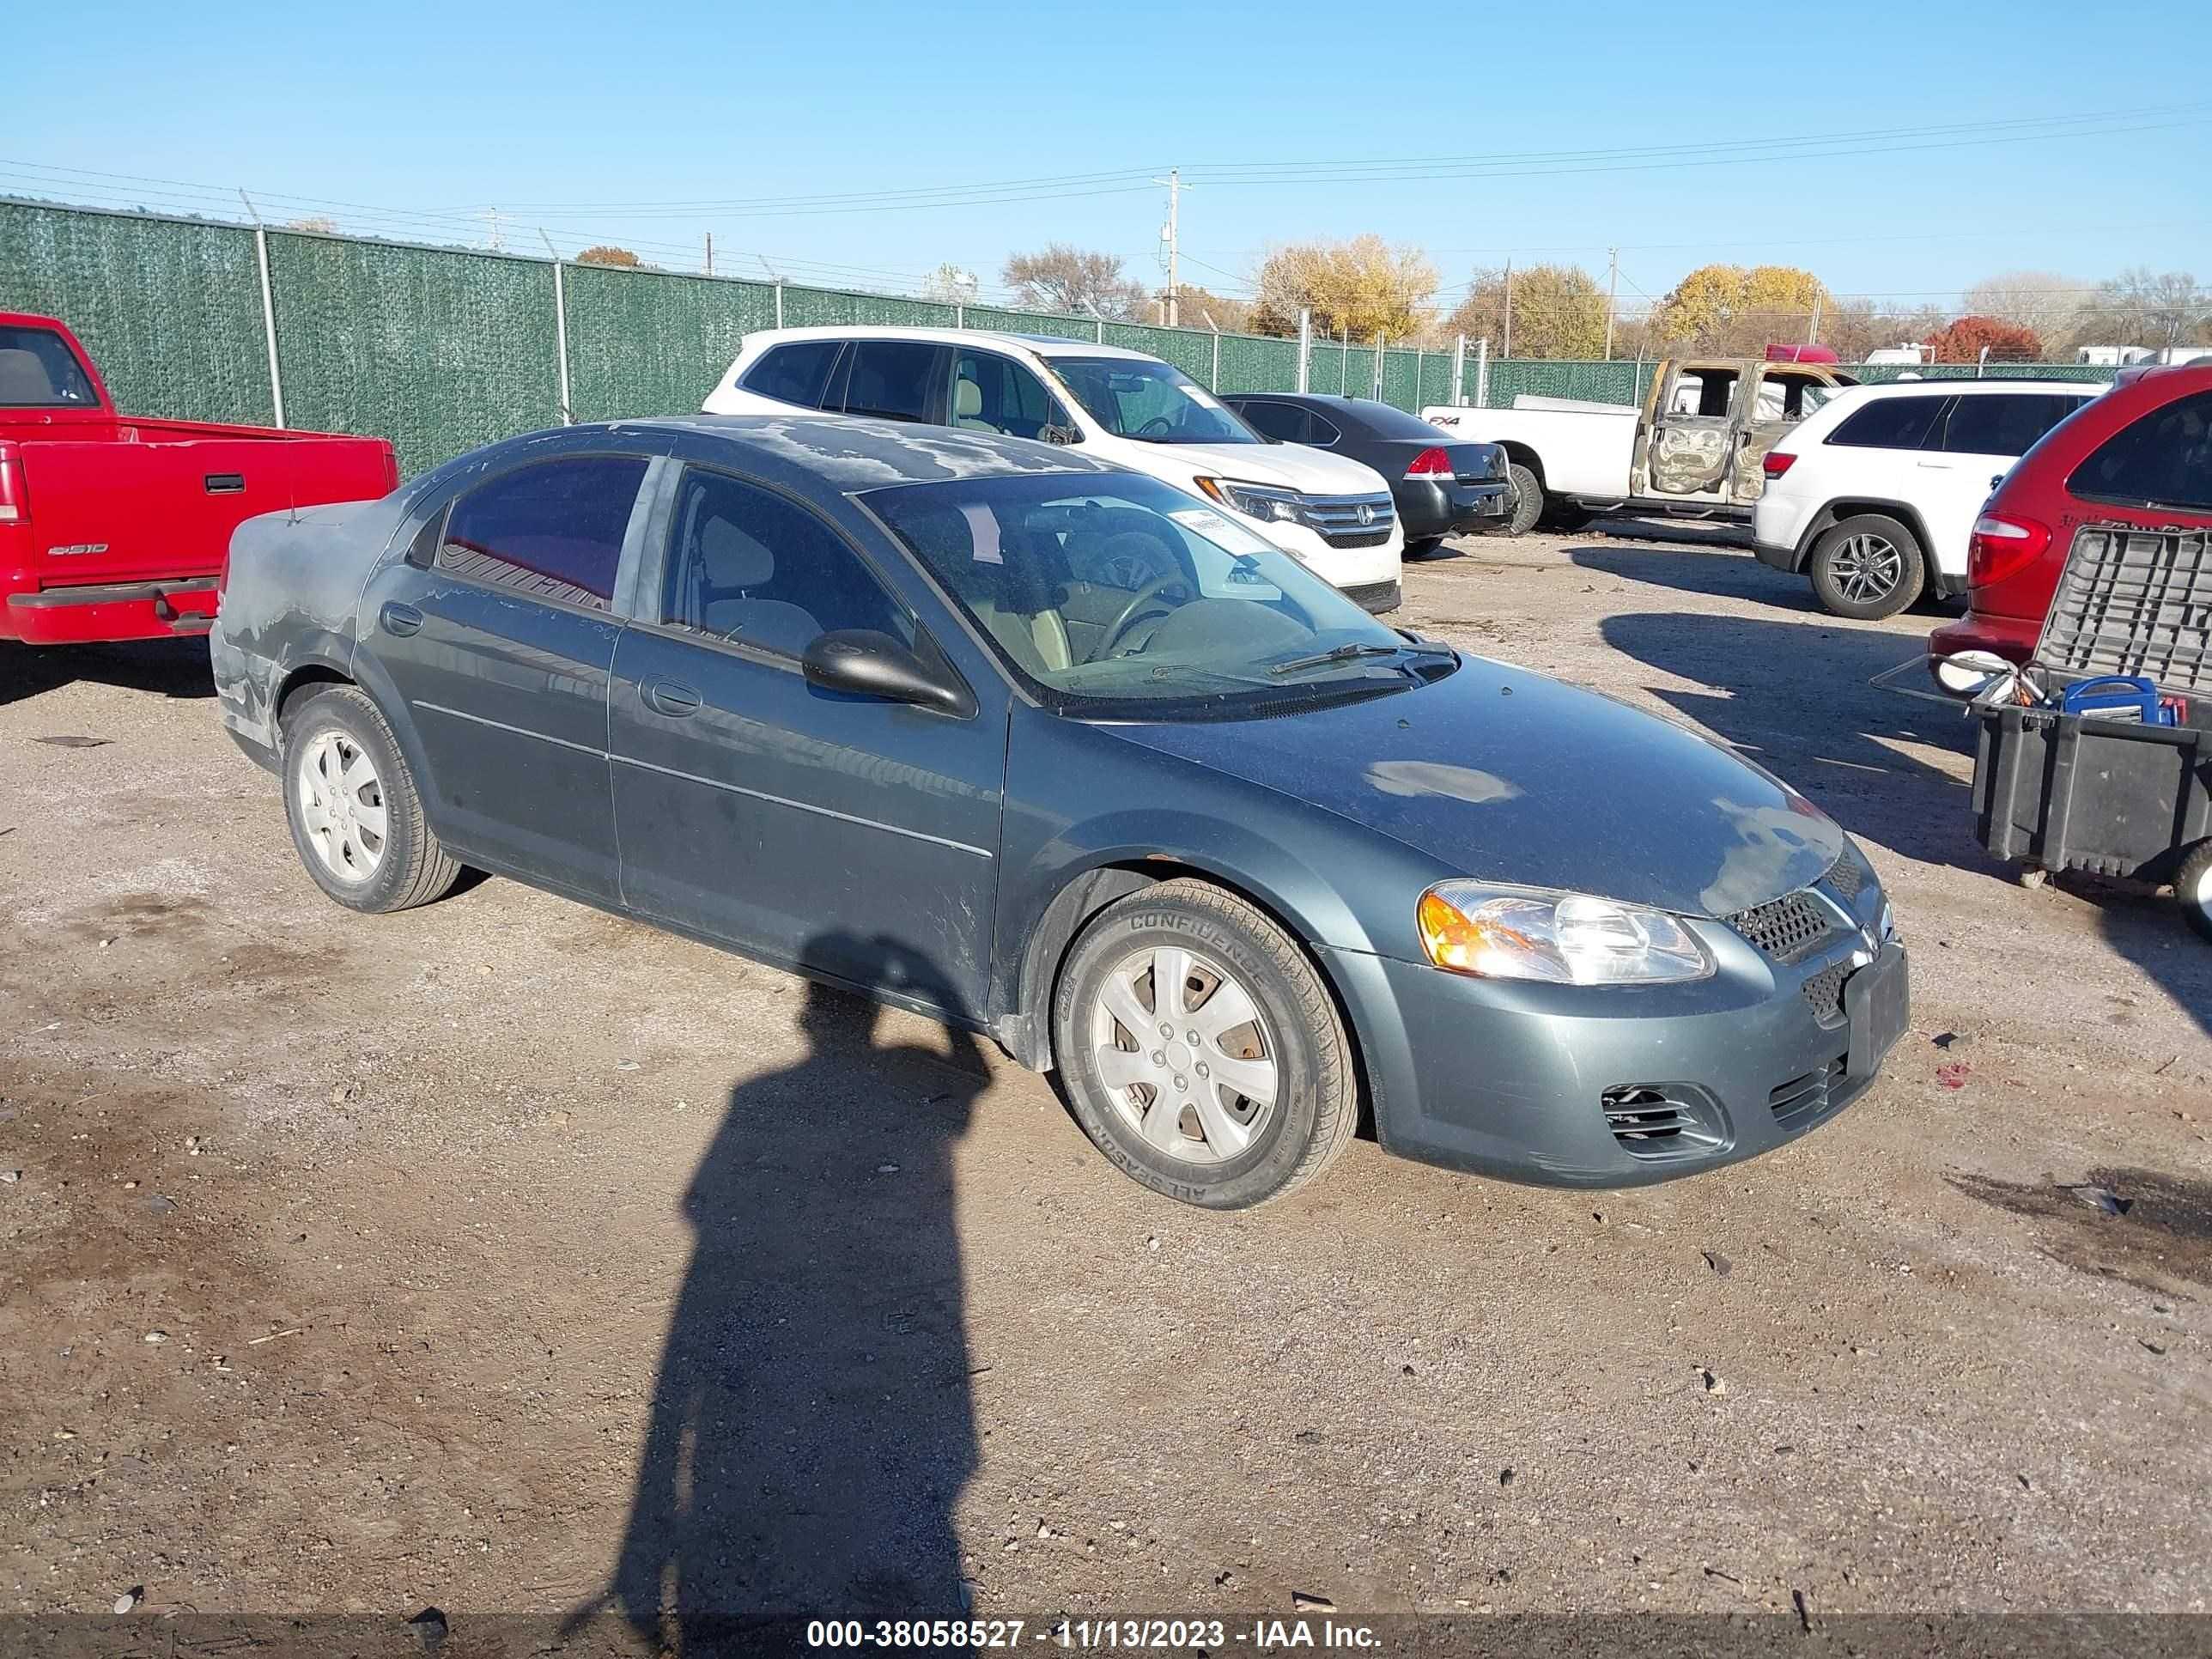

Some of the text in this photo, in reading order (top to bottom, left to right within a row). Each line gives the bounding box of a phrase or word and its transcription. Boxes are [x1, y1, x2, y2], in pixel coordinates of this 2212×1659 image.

[1428, 416, 1460, 426] FX4
[1130, 912, 1267, 989] CONFIDENCE
[1091, 1123, 1207, 1201] ALL SEASON
